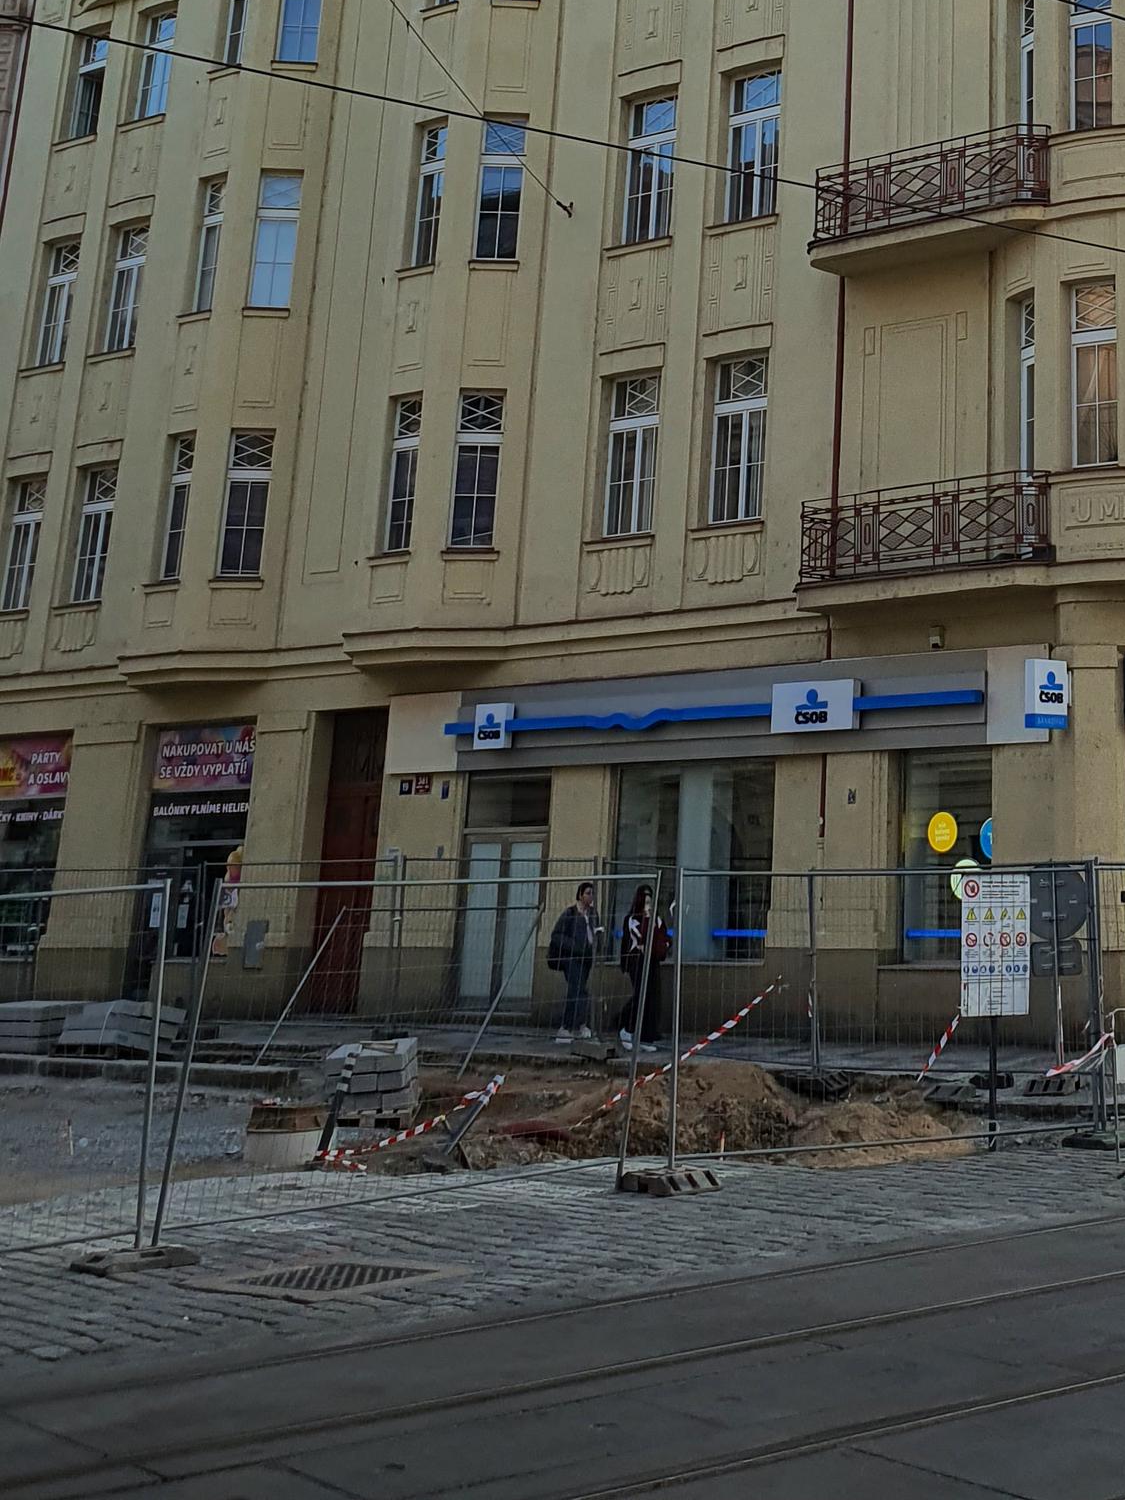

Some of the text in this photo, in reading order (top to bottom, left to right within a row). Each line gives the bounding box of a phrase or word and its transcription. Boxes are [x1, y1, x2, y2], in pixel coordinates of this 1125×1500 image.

[1039, 690, 1064, 704] ČSOB
[794, 710, 828, 725] ČSOB
[477, 729, 501, 741] ČSOB
[162, 741, 224, 758] NAKUPOVAT
[225, 740, 233, 753] U
[31, 749, 61, 765] PÁRTY
[160, 758, 248, 779] SE VŽDY VYPLATÍ!
[28, 773, 34, 785] A
[153, 803, 191, 817] BALÓNKY
[191, 801, 221, 815] PLNÍME
